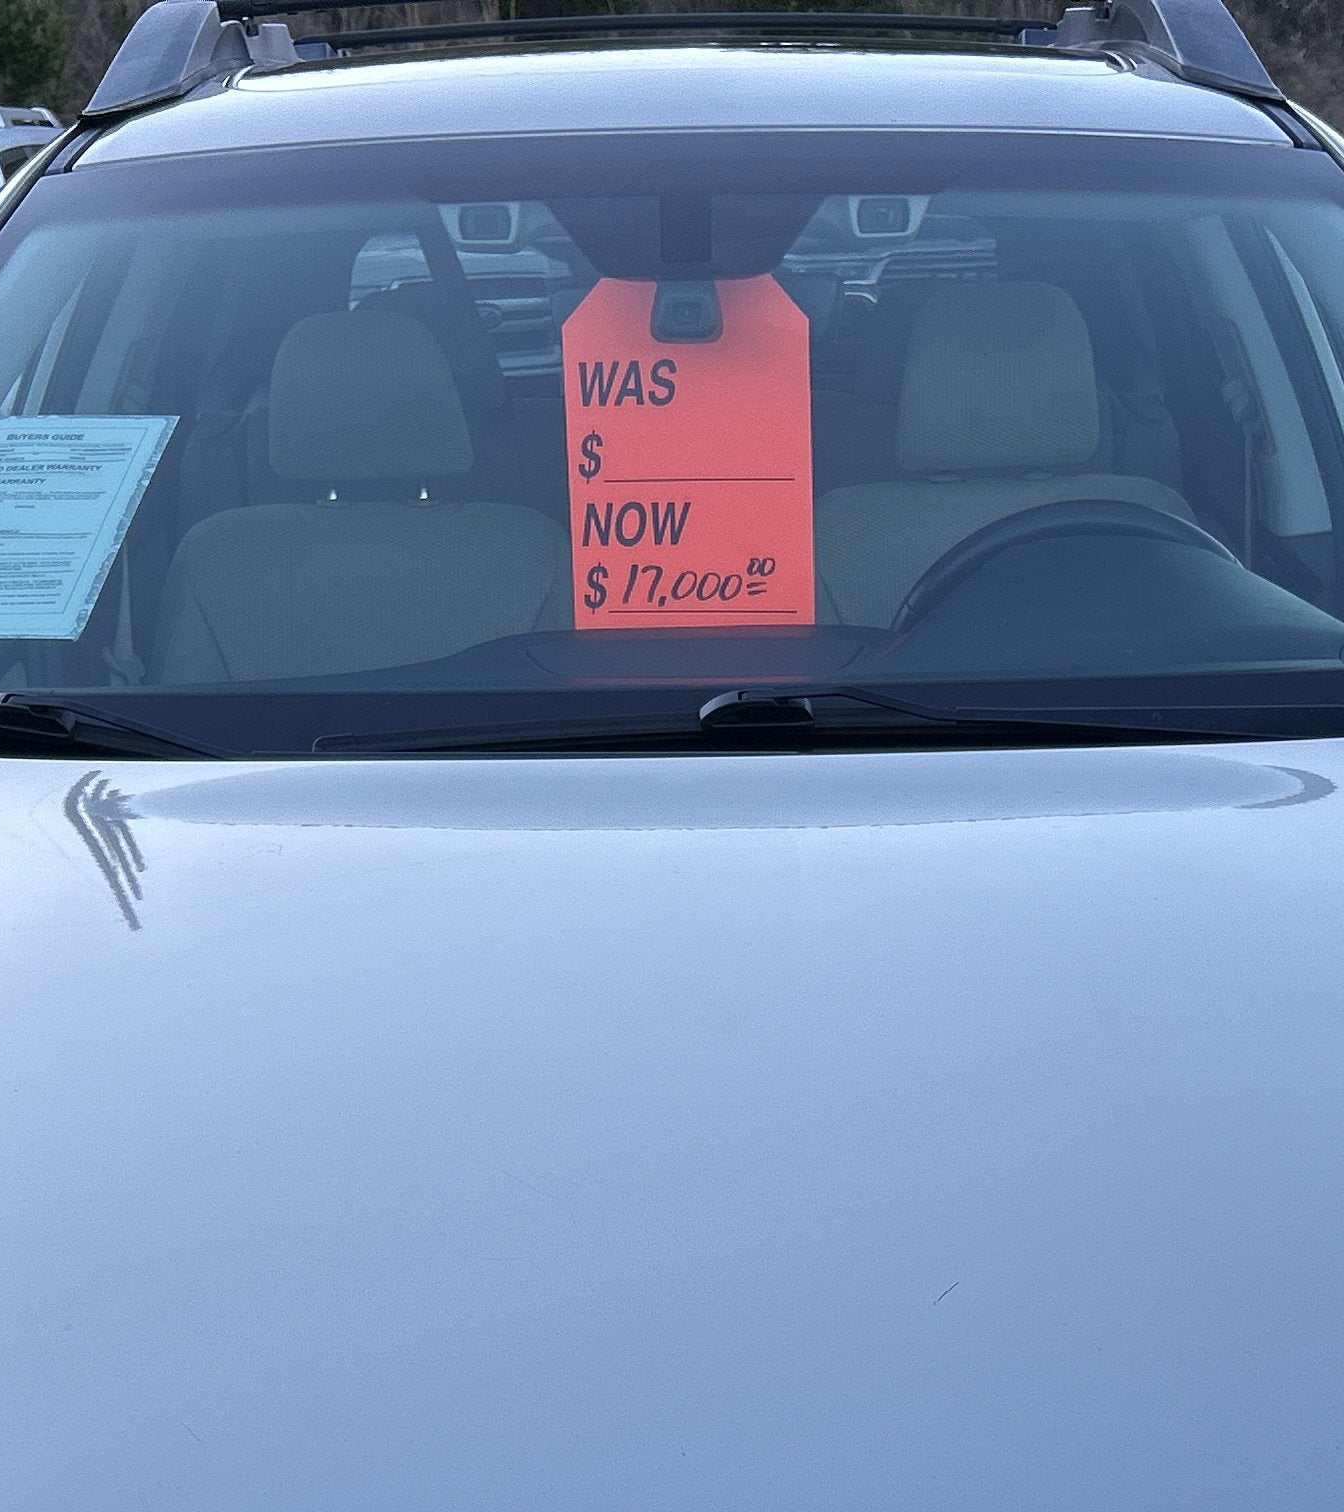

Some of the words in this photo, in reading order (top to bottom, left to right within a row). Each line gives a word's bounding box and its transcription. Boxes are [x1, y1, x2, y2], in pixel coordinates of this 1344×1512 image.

[578, 358, 677, 407] WAS
[6, 433, 49, 441] BUYERS
[52, 433, 85, 441] GUIDE
[578, 430, 603, 484] $
[5, 464, 45, 472] DEALER
[46, 464, 103, 472] WARRANTY
[582, 501, 691, 547] NOW
[584, 562, 609, 615] $
